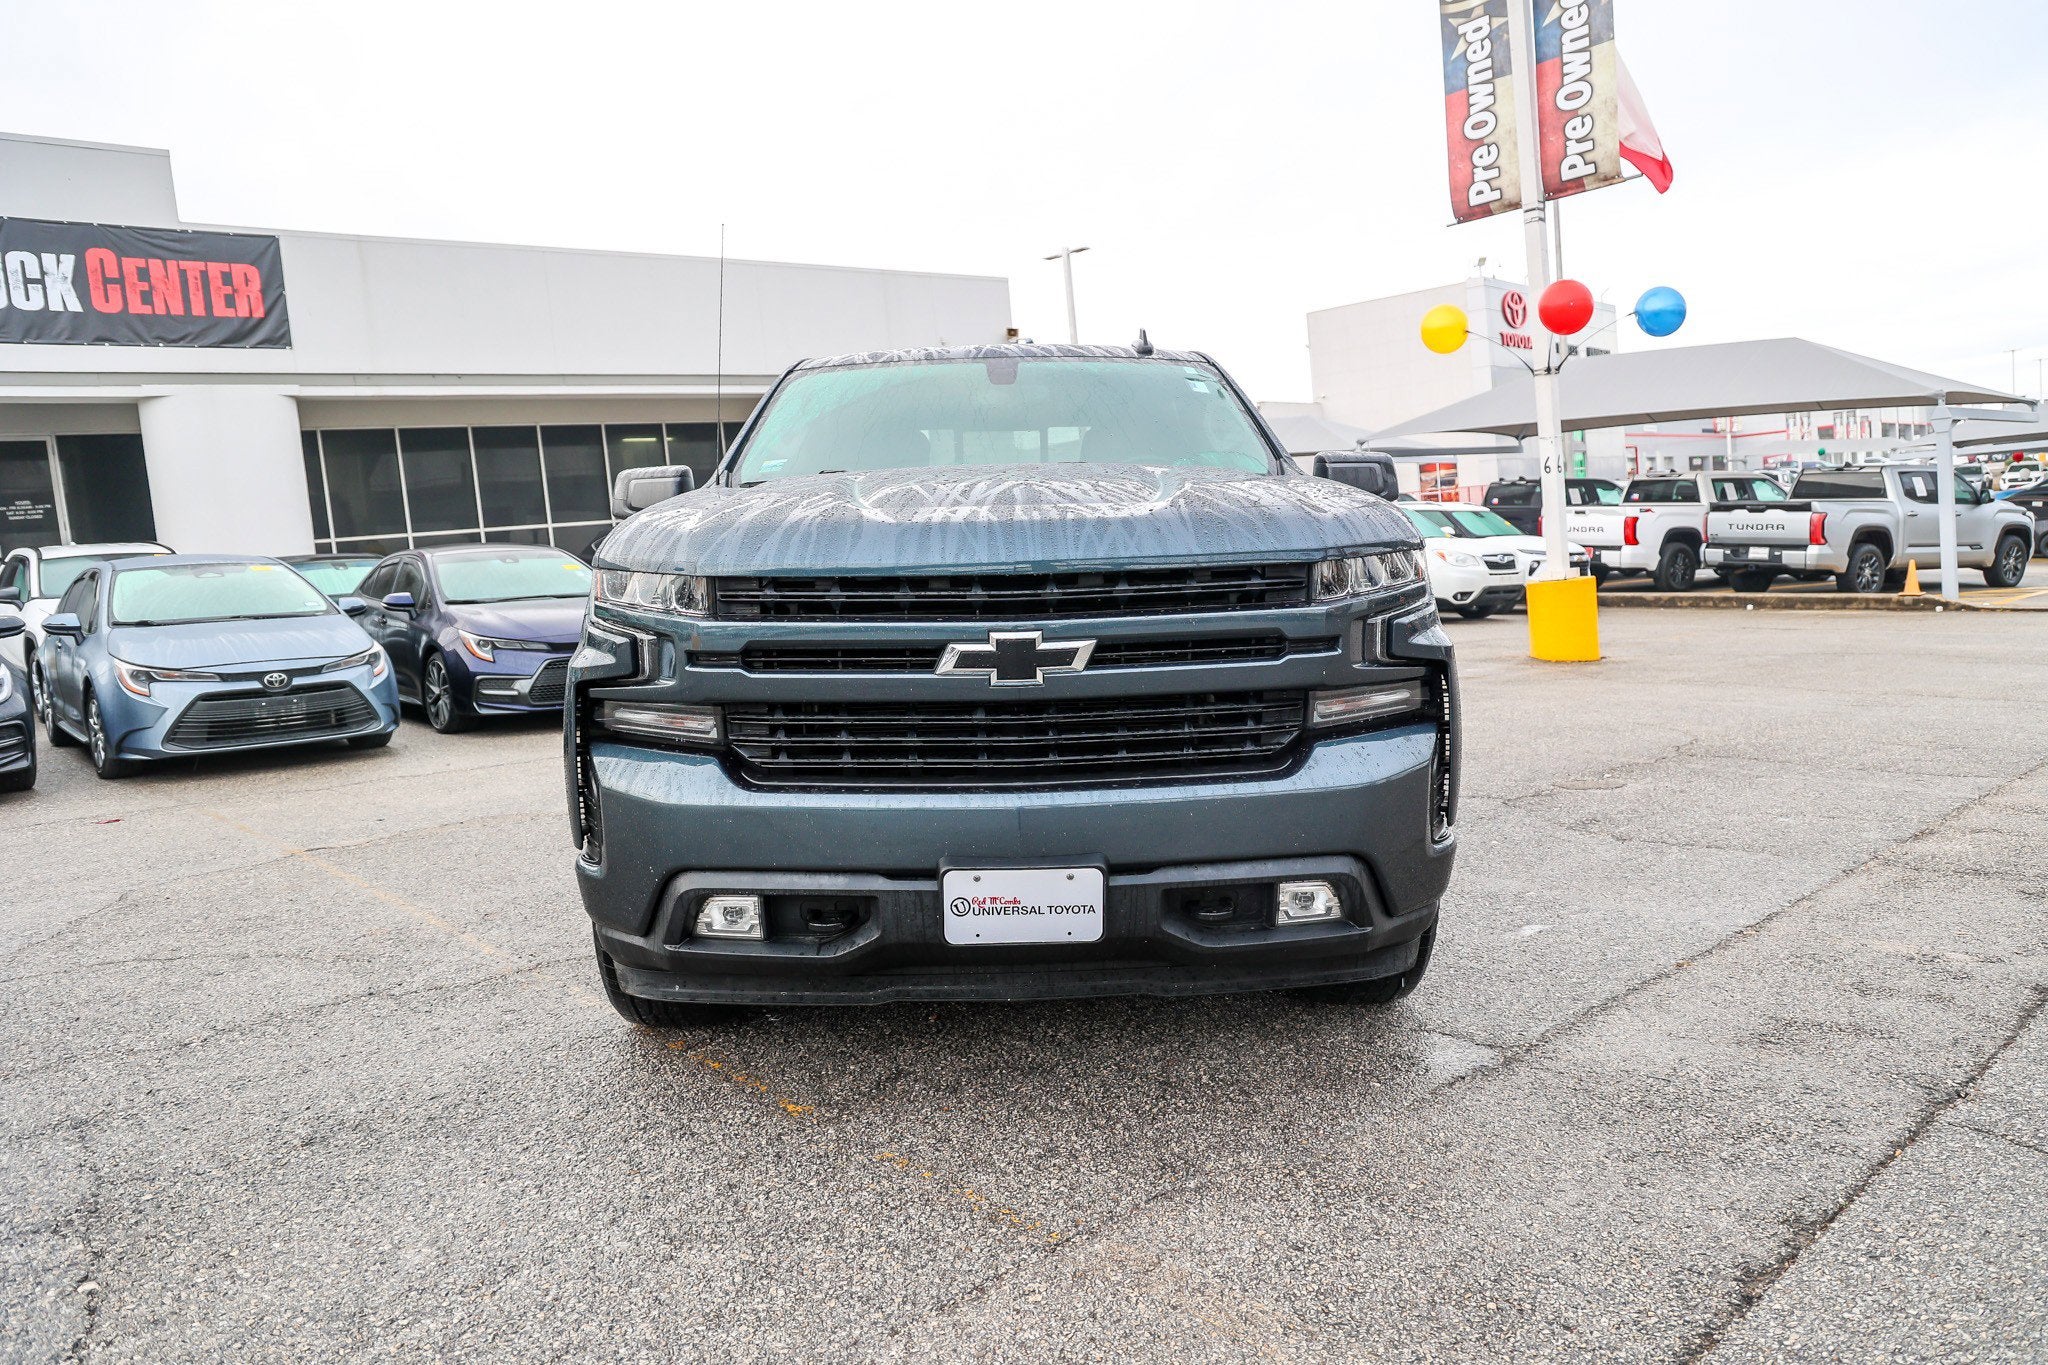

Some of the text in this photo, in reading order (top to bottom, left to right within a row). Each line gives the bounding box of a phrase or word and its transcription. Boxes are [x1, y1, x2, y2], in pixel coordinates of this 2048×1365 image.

[1457, 14, 1501, 207] Pre Owned
[1560, 114, 1596, 182] Pre
[0, 247, 266, 318] CK CENTER
[1544, 456, 1551, 474] 6
[1728, 523, 1785, 531] TUNDRA
[972, 896, 987, 909] Red
[972, 904, 1096, 916] UNIVERSAL TOYOTA
